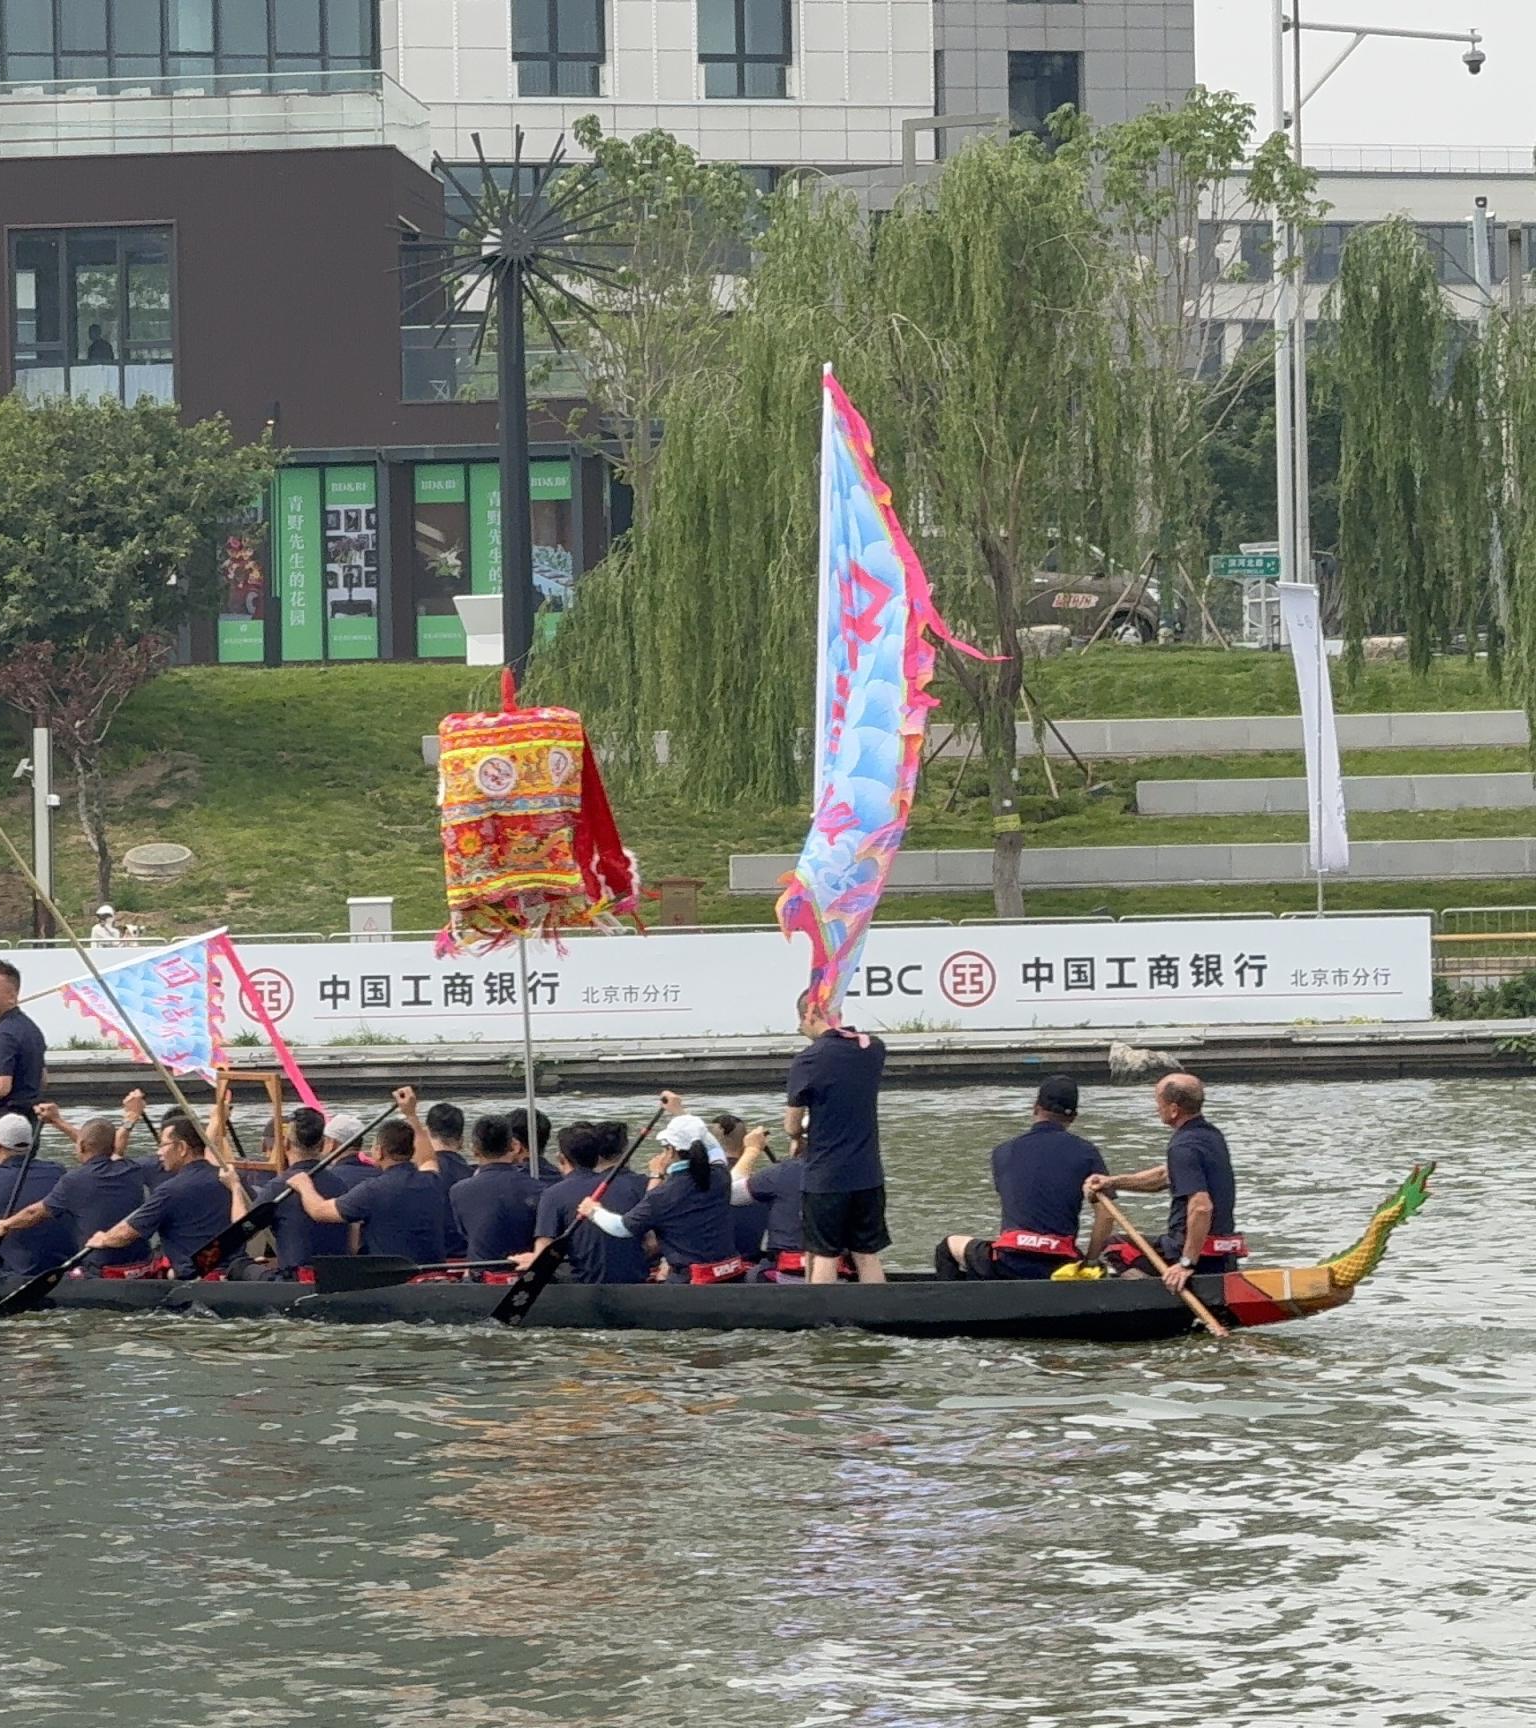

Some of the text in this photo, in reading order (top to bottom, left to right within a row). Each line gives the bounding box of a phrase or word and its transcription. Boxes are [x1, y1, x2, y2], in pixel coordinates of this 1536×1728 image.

[288, 495, 306, 627] 青野先生的花园
[318, 970, 681, 1011] 中国工商银行 北京市分行
[1021, 952, 1392, 993] 中国工商银行 北京市分行
